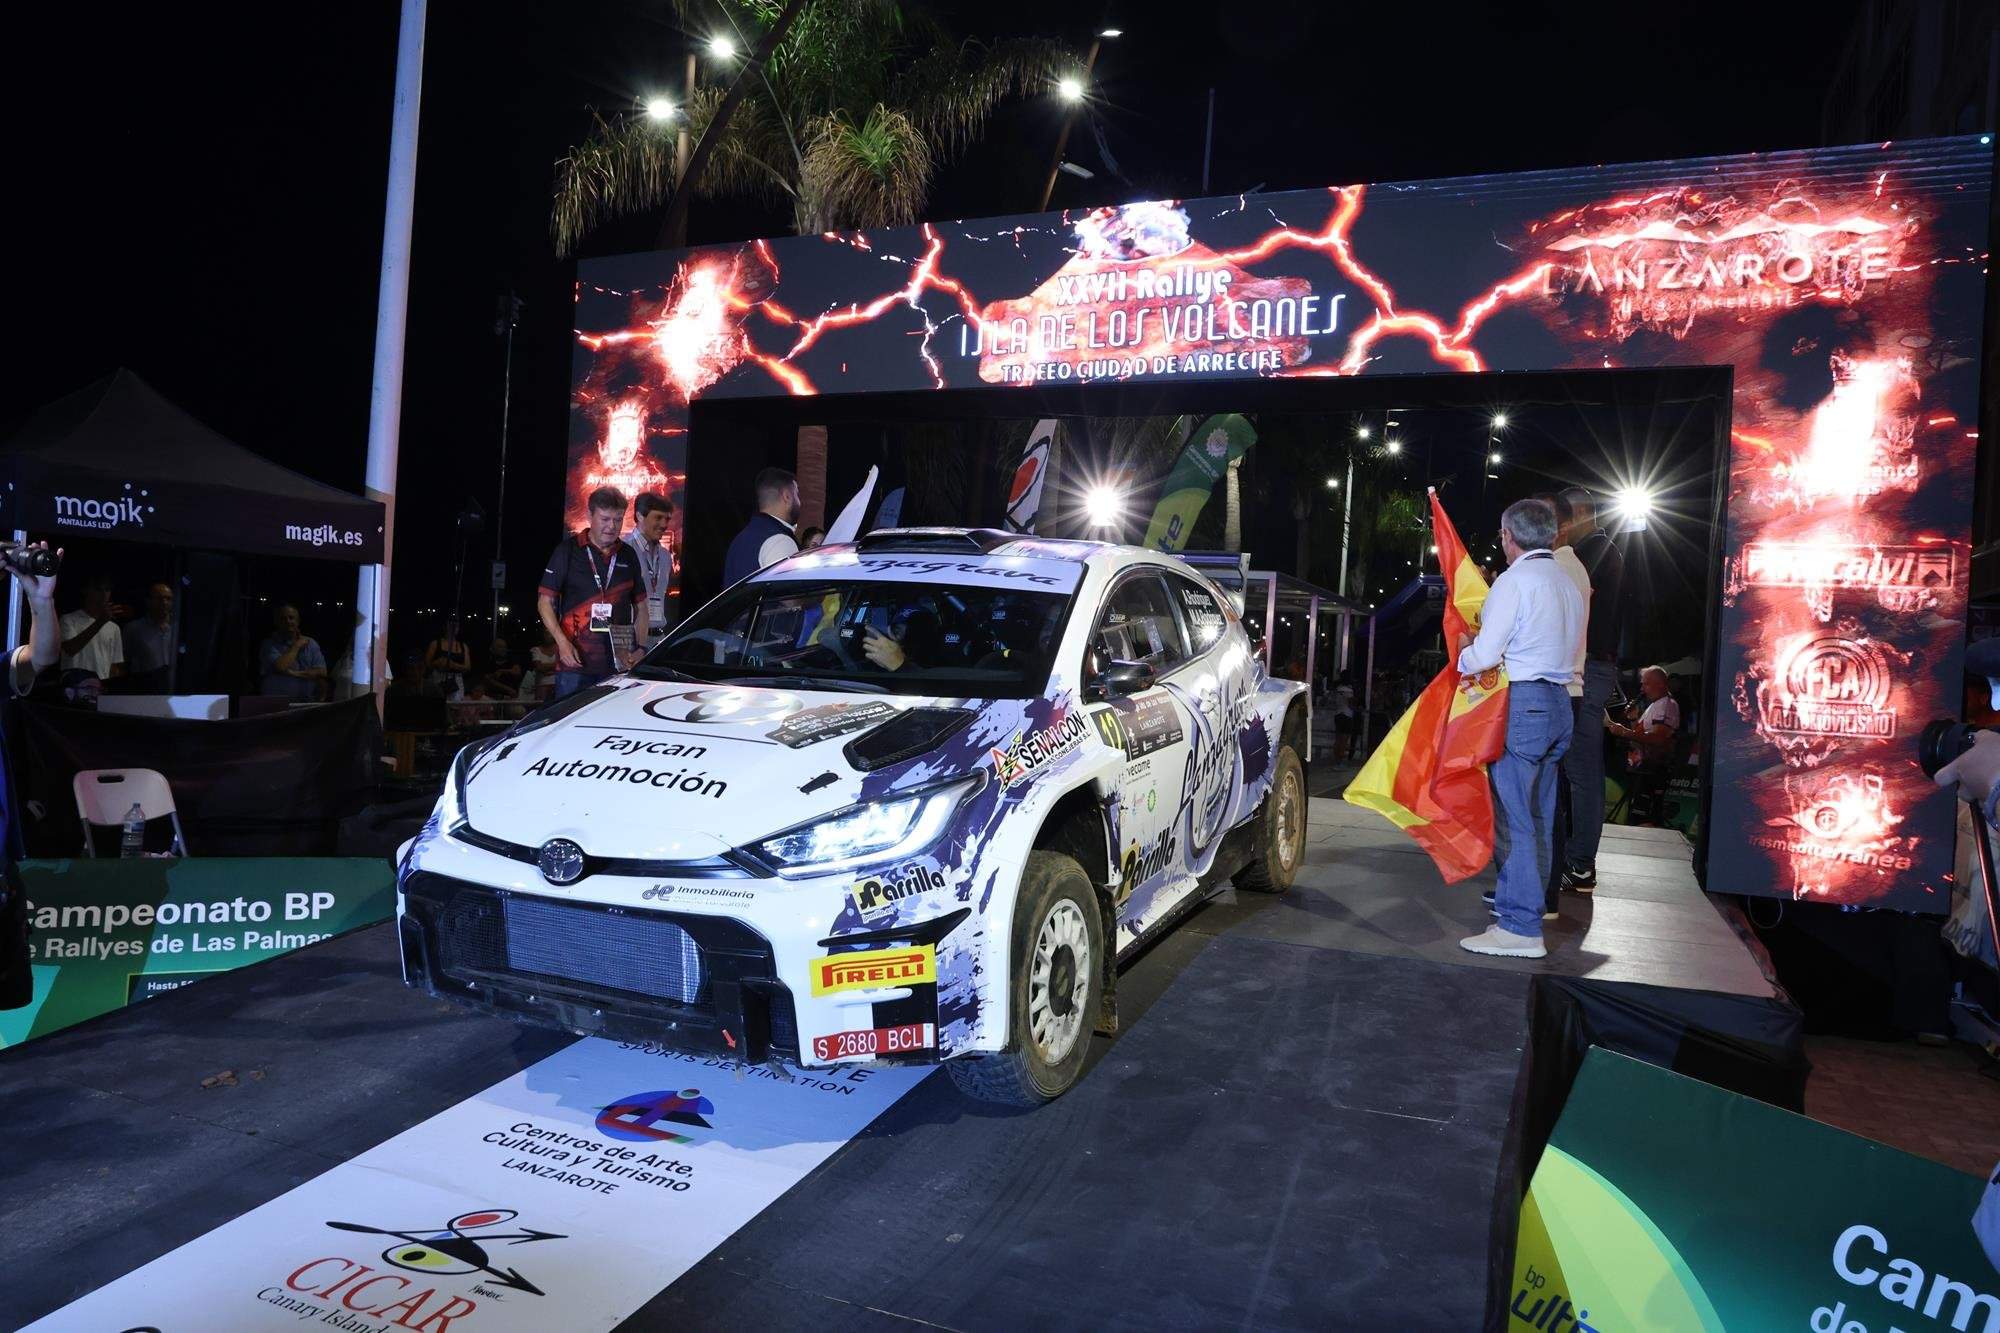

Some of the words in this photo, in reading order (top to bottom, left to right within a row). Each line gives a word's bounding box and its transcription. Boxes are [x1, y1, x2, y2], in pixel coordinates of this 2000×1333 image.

[1057, 271, 1127, 306] XXVII
[1136, 264, 1232, 304] Rallye
[1542, 247, 1891, 294] LANZAROTE
[961, 318, 1028, 358] ISLA
[1088, 308, 1151, 350] LOS
[1161, 293, 1346, 343] VOLCANES
[1001, 362, 1071, 383] TROFEO
[1077, 357, 1148, 379] CIUDAD
[1152, 355, 1178, 374] DE
[1183, 349, 1282, 372] ARRECIFE
[55, 496, 143, 526] magik
[57, 518, 97, 528] PANTALLAS
[285, 523, 363, 547] magik.es
[1807, 657, 1861, 700] FCA
[593, 735, 708, 759] Faycan
[1019, 710, 1087, 769] SEÑALCON
[522, 756, 728, 799] Automoción
[285, 891, 336, 921] BP
[678, 886, 755, 900] Inmobiliaria
[45, 937, 144, 961] Rallyes
[151, 934, 183, 954] de
[192, 932, 236, 952] Las
[148, 982, 178, 990] Hasta
[822, 953, 925, 988] PIRELLI
[818, 1039, 829, 1060] S
[837, 1031, 878, 1056] 2680
[887, 1026, 922, 1051] BCL
[703, 1058, 856, 1096] DETINTION
[482, 1131, 570, 1162] Cultura
[567, 1155, 590, 1168] y
[592, 1157, 692, 1193] Turismo
[510, 1122, 603, 1152] Centros
[604, 1147, 636, 1161] de
[636, 1154, 694, 1178] Arte,
[502, 1158, 620, 1195] LANZAROTE
[285, 1257, 478, 1333] CICAR
[1525, 1265, 1546, 1290] bp
[256, 1286, 321, 1321] Canary
